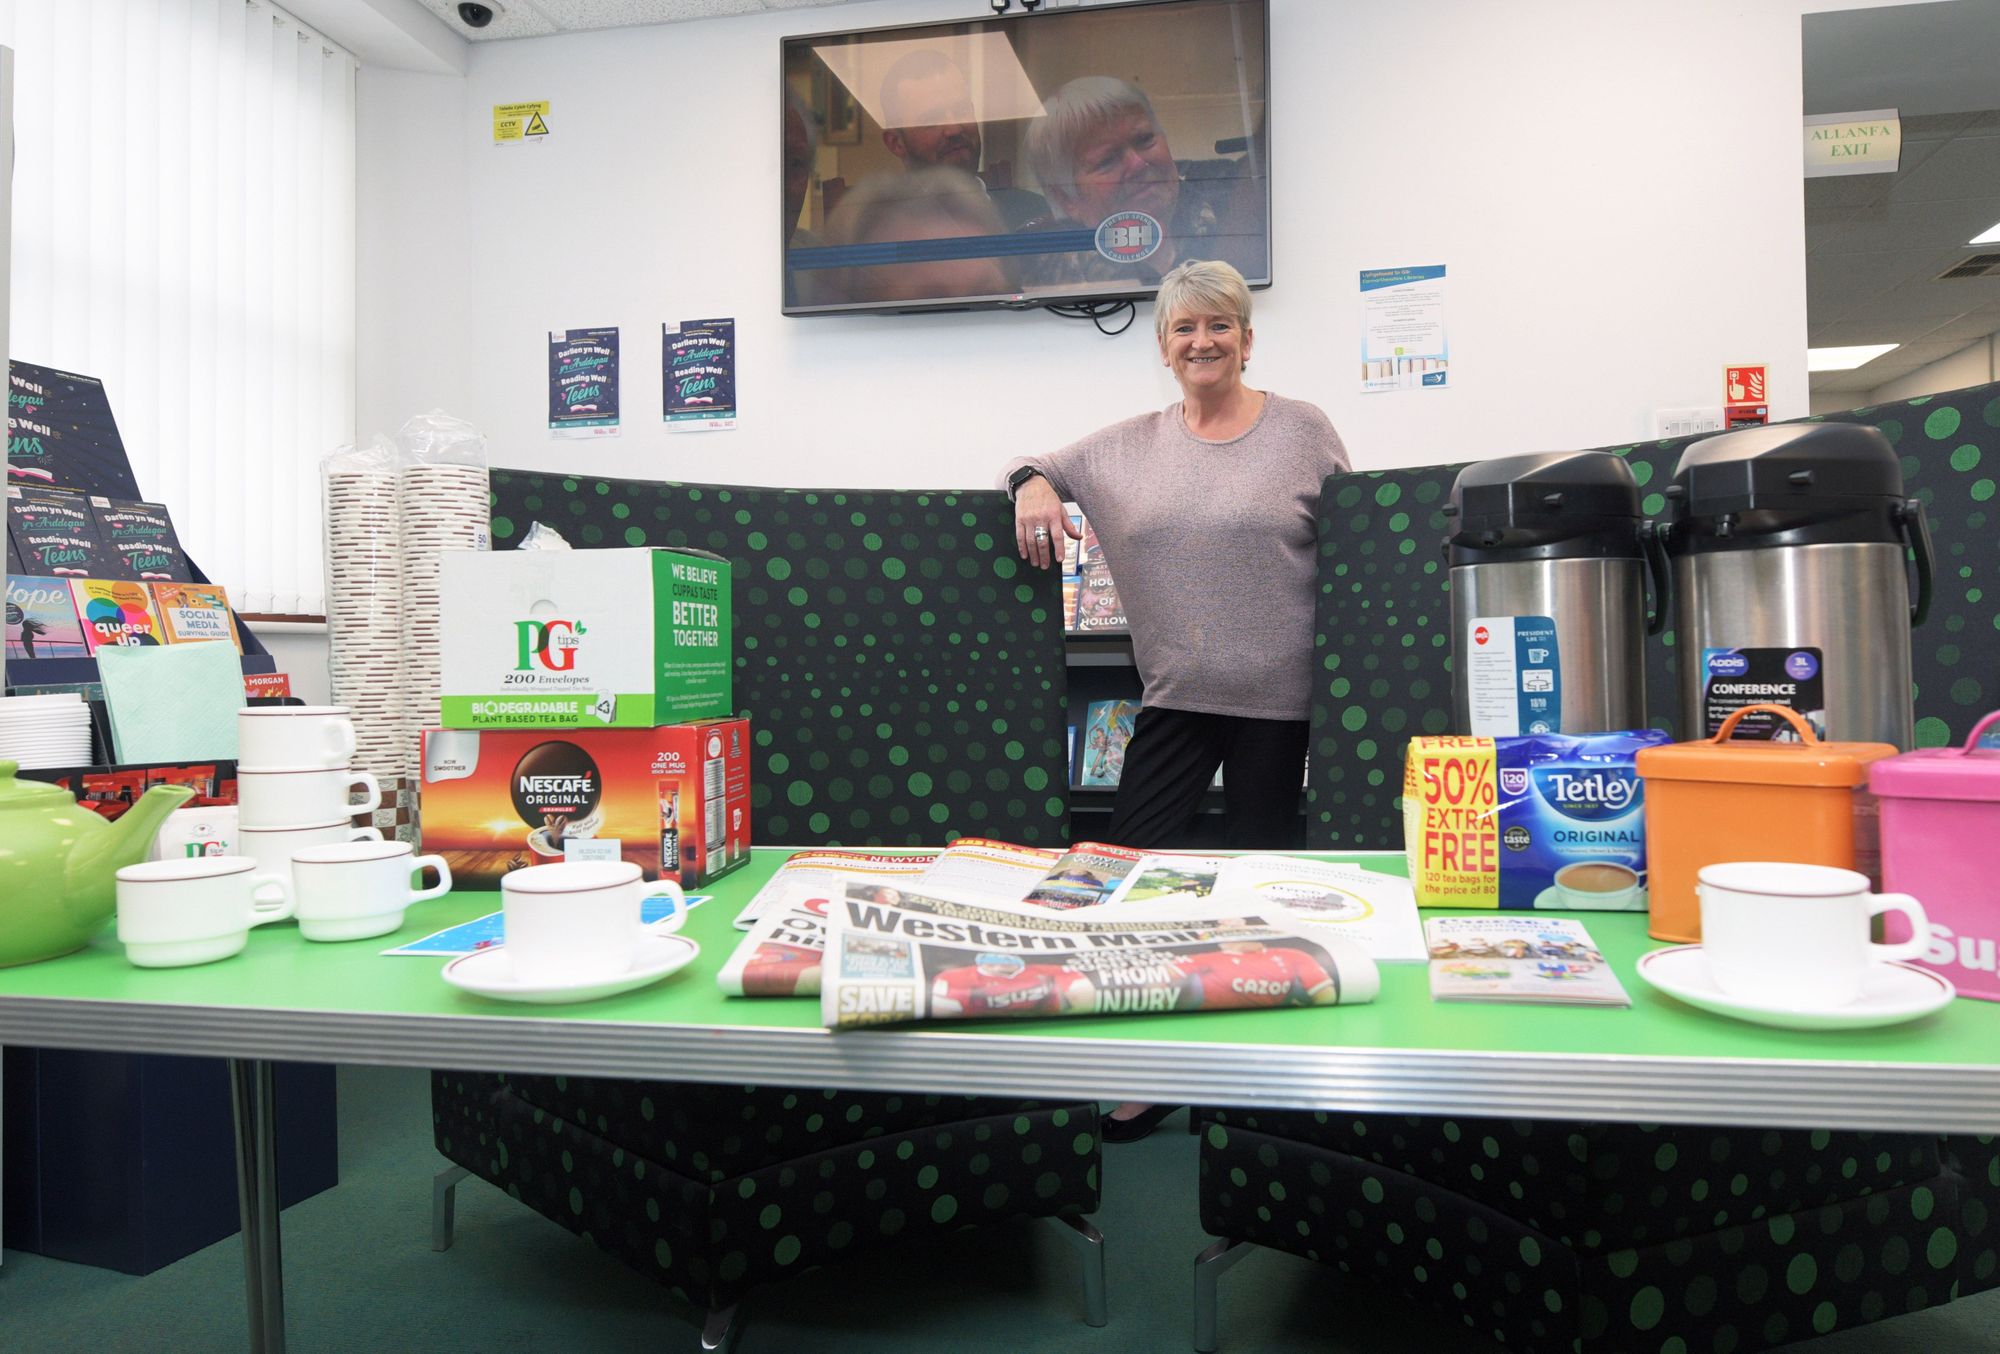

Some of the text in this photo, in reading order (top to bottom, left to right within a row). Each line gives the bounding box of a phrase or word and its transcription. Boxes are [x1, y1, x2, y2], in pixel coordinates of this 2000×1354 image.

[1811, 126, 1890, 140] ALLANFA
[1831, 142, 1871, 157] EXIT
[1105, 225, 1153, 248] BH
[1108, 248, 1150, 260] CHALLENGE
[672, 338, 698, 350] Darllen
[709, 337, 726, 347] Well
[558, 346, 611, 359] Darllen yn Well
[675, 366, 723, 378] Reading Well
[11, 375, 43, 395] Well
[561, 374, 607, 385] Reading Well
[679, 376, 716, 397] Teens
[565, 384, 600, 405] Teens
[18, 417, 51, 436] Well
[14, 504, 48, 514] Darllen
[62, 508, 84, 519] Well
[104, 512, 135, 522] Darllen
[146, 516, 166, 527] Well
[28, 535, 91, 548] Reading Well
[478, 534, 487, 544] 50
[117, 542, 173, 554] Reading Well
[38, 545, 87, 566] Teens
[127, 551, 169, 571] Teens
[671, 563, 718, 585] WE BELIEVE
[672, 583, 718, 601] CUPPAS TASTE
[1099, 597, 1115, 606] OF
[179, 610, 219, 620] SOCIAL
[672, 601, 718, 627] BETTER
[95, 621, 151, 637] queer
[187, 621, 220, 630] MEDIA
[116, 633, 141, 647] up
[673, 629, 718, 647] TOGETHER
[513, 620, 580, 671] PG tips
[249, 676, 284, 686] MORGAN
[504, 674, 590, 686] 200 Envelopes
[1712, 683, 1797, 695] CONFERENCE
[472, 700, 578, 716] BIODEGRADABLE
[473, 715, 578, 723] PLANT BASED TEA BAG
[1421, 736, 1493, 749] FREE
[657, 752, 680, 761] 200
[1424, 758, 1495, 805] 50%
[1504, 773, 1525, 784] 120
[1549, 773, 1640, 810] Tetley
[526, 795, 589, 804] ORIGINAL
[1427, 807, 1495, 831] EXTRA
[1503, 835, 1530, 844] taste
[1554, 830, 1640, 843] ORIGINAL
[1425, 831, 1496, 873] FREE
[870, 855, 937, 864] NEWYDD
[1425, 872, 1496, 886] 120 tea bags for
[1425, 884, 1497, 896] the price of 80
[846, 901, 1077, 950] Western
[1087, 931, 1200, 947] Mail
[1921, 923, 2000, 978] Su
[1099, 965, 1172, 986] FROM
[841, 985, 914, 1013] SAVE
[1094, 986, 1181, 1012] INJURY
